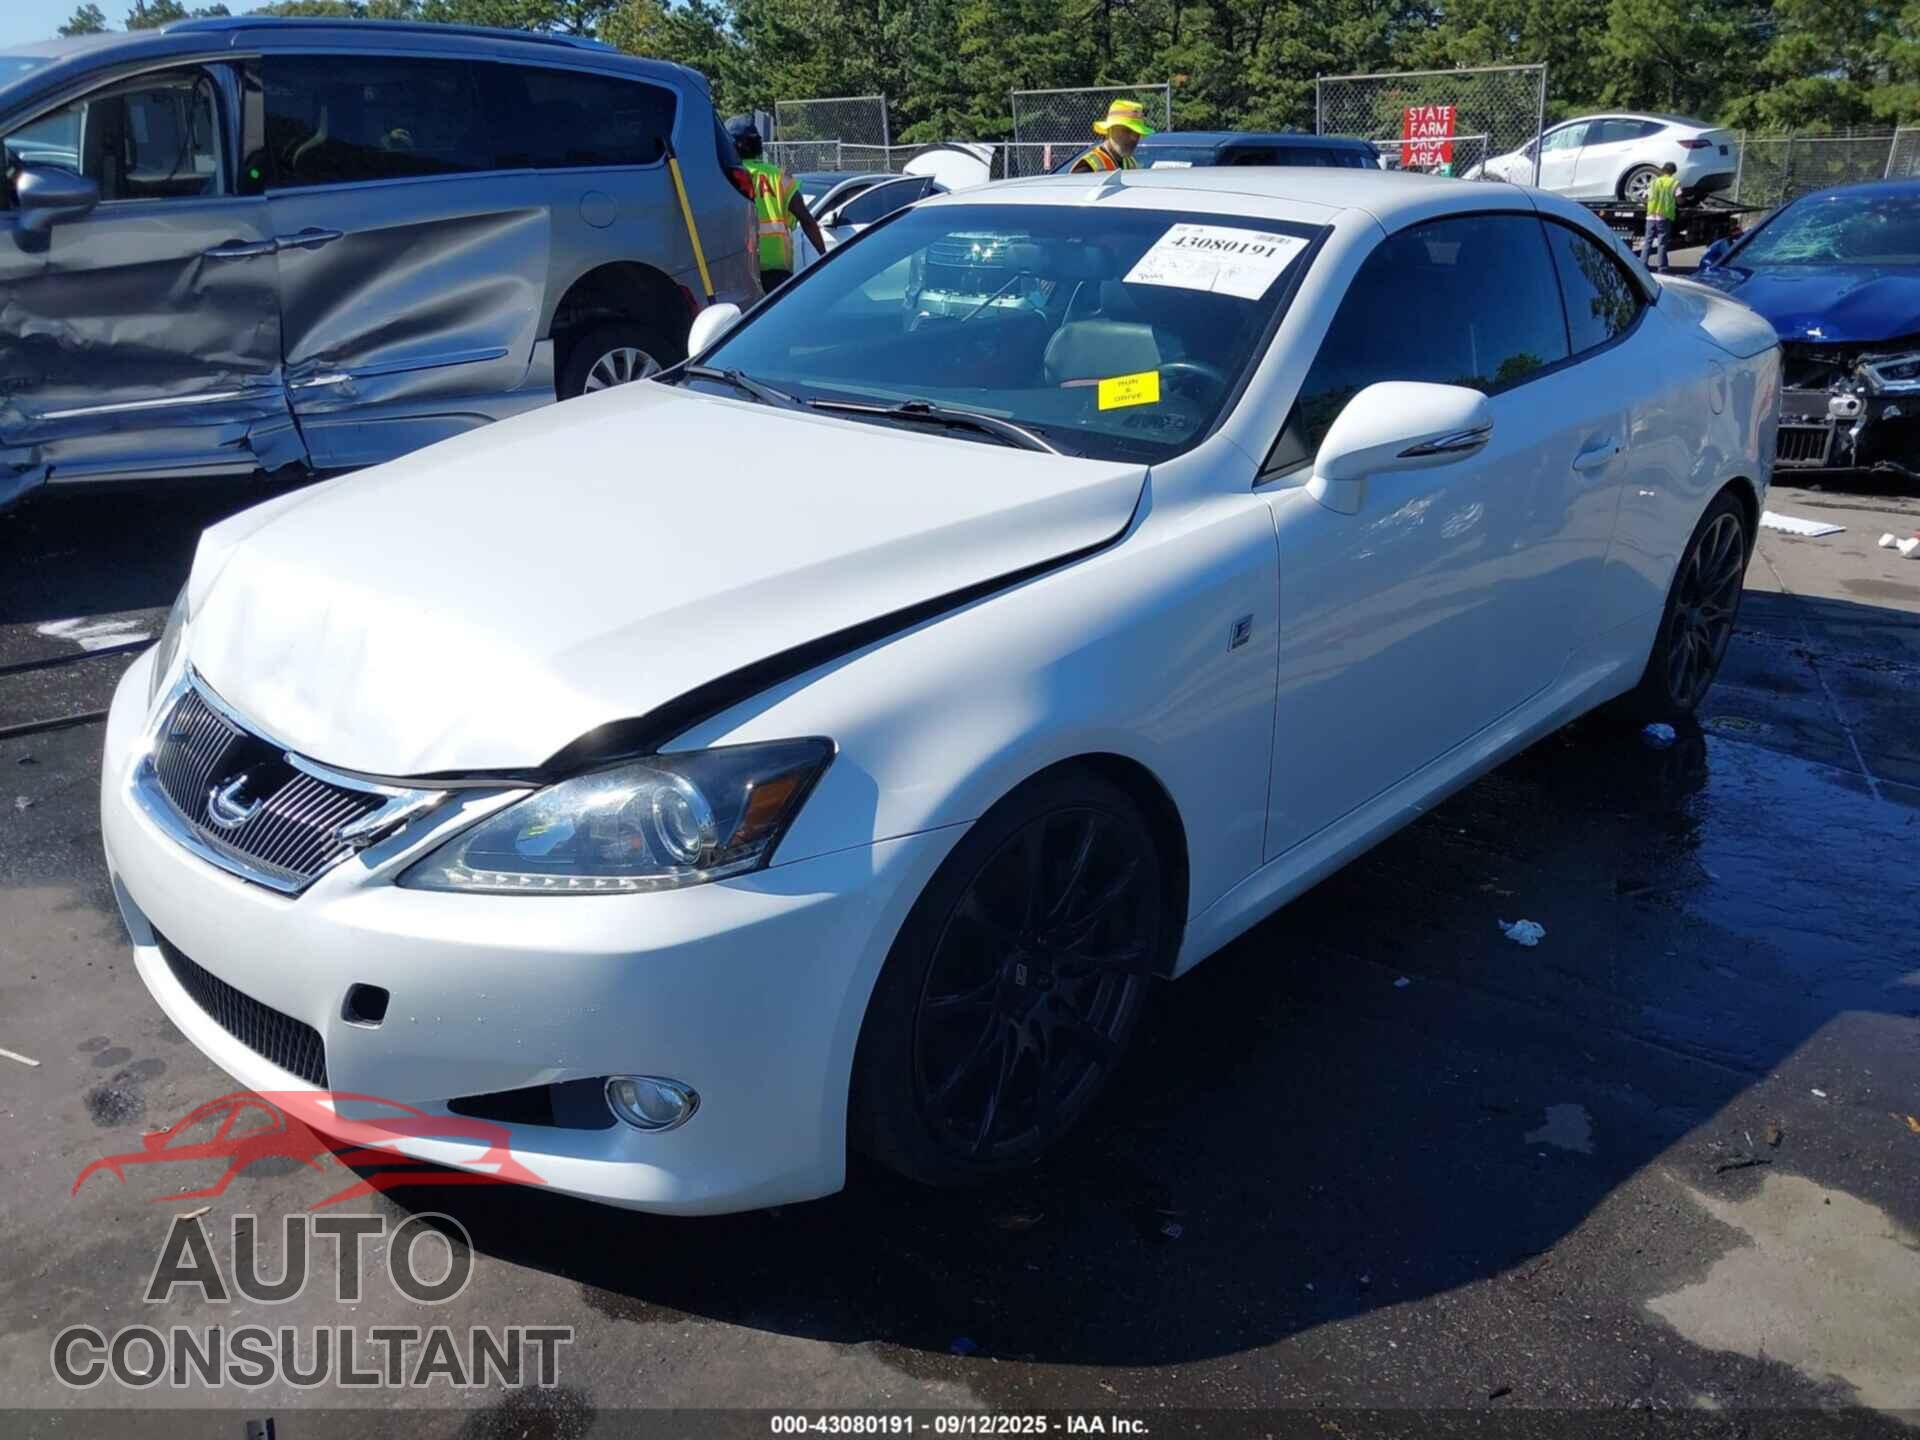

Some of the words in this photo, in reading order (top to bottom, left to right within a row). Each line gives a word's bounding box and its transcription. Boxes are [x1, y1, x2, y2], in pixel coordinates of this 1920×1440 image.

[1409, 106, 1450, 121] STATE
[1409, 122, 1448, 136] FARM
[1409, 137, 1445, 150] DROP
[1408, 152, 1444, 166] AREA
[1171, 234, 1278, 258] 43080191
